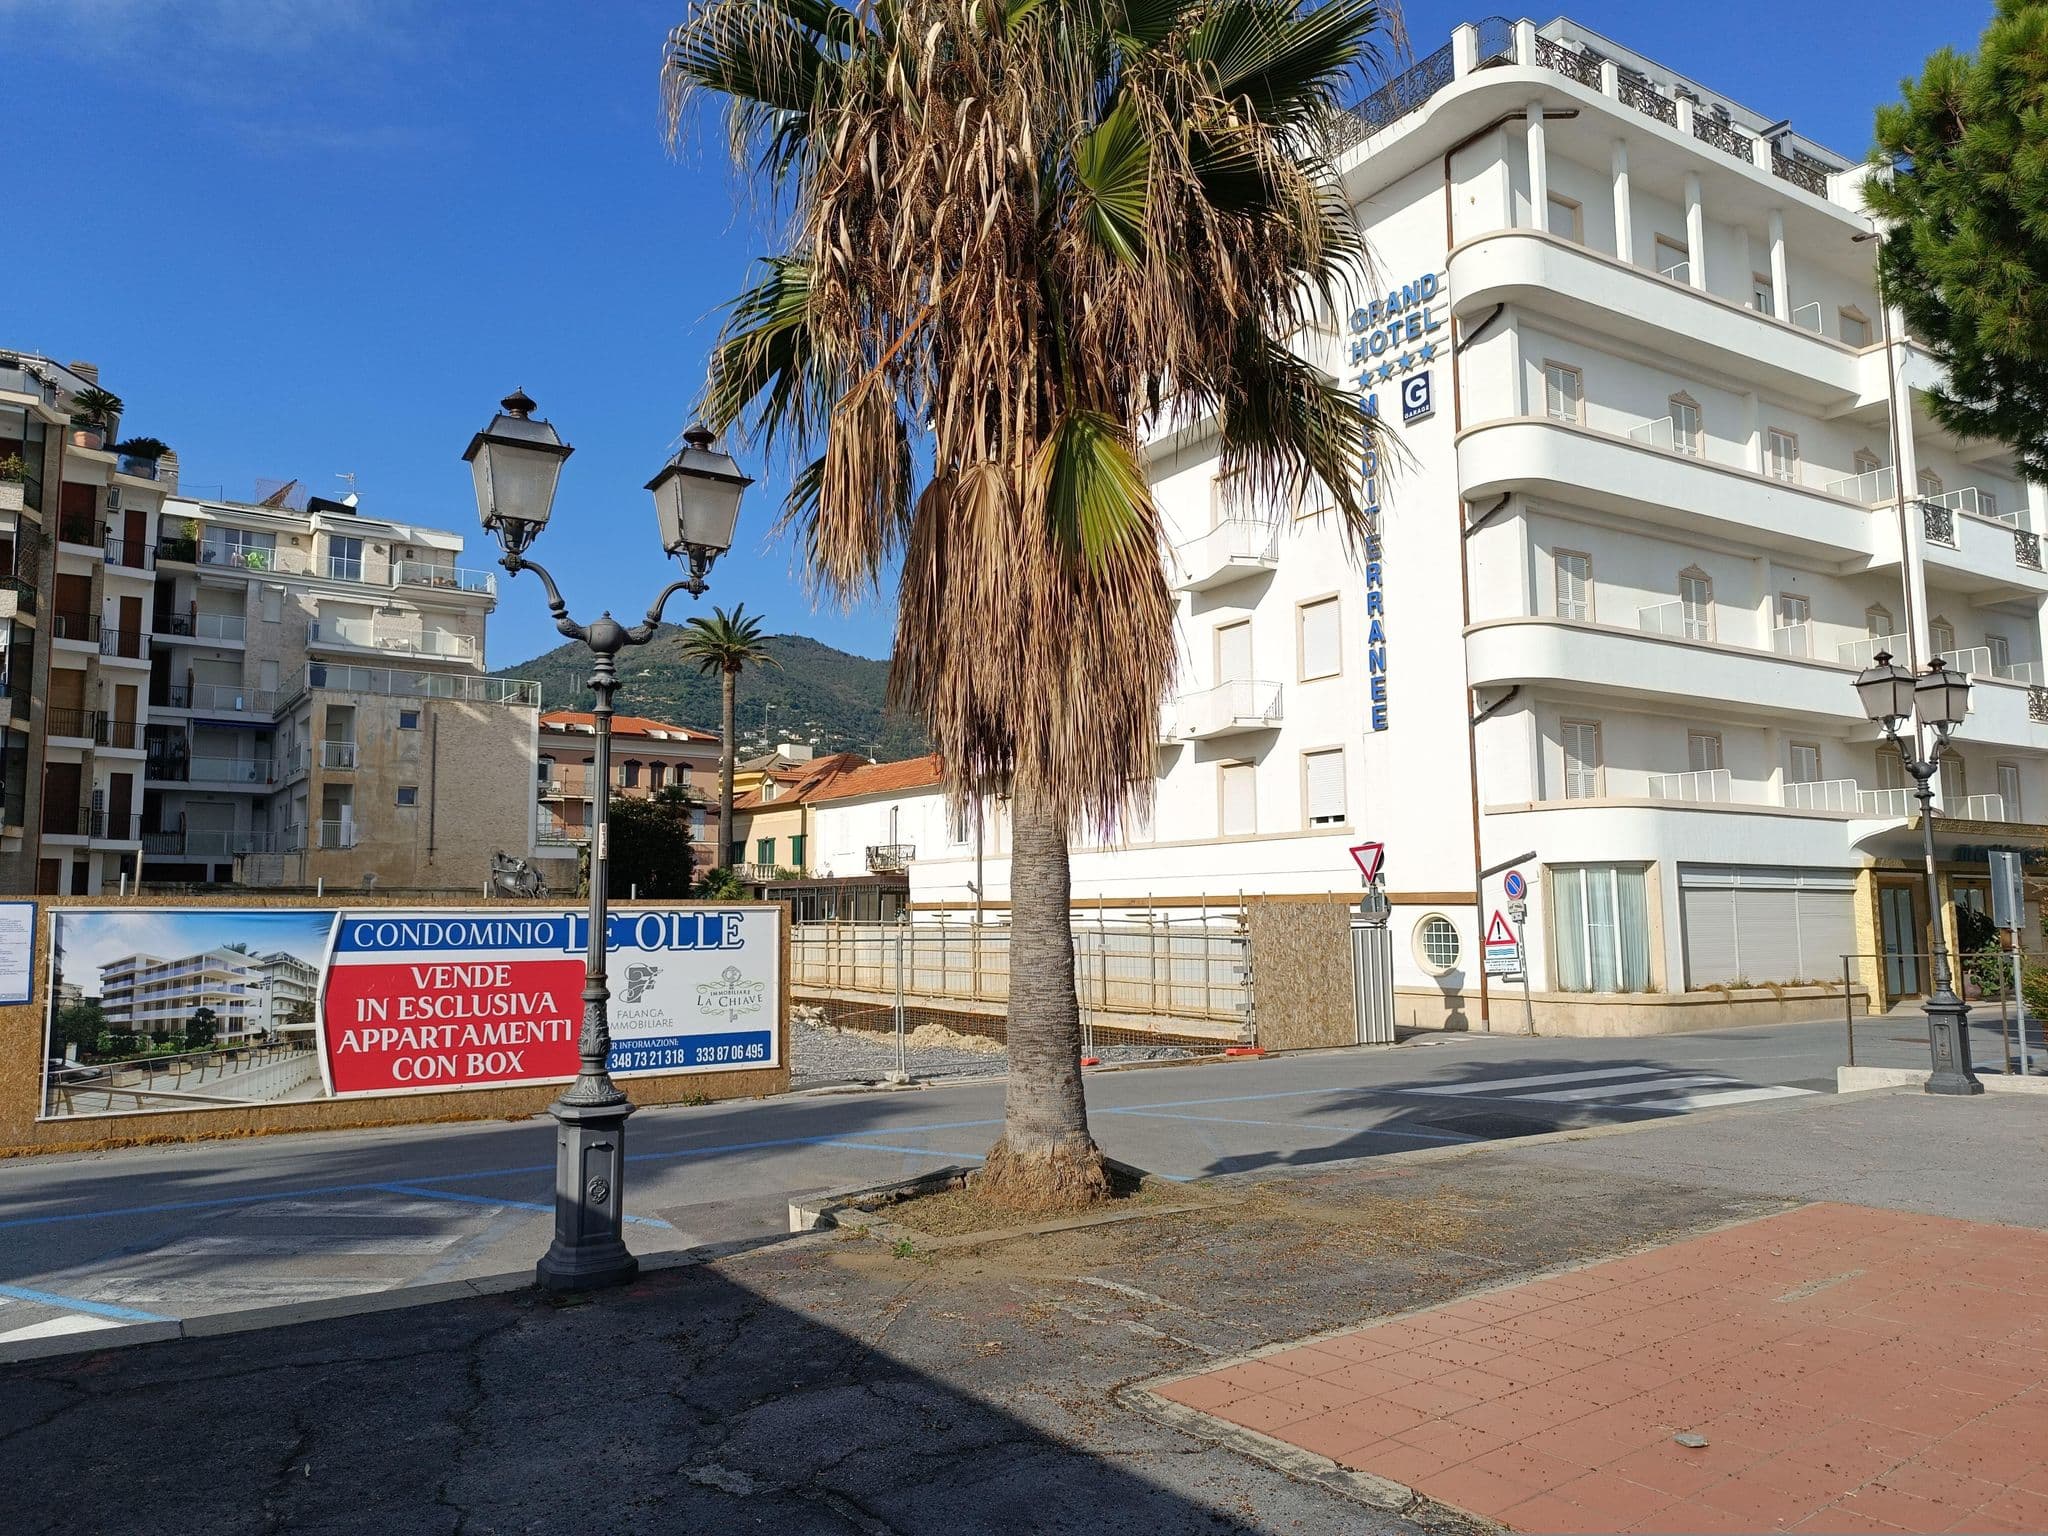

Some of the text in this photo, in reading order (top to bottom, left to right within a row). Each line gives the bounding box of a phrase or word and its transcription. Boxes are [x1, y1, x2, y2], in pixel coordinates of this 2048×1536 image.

[1351, 273, 1438, 334] GRAND
[1352, 307, 1440, 365] HOTEL
[1405, 377, 1427, 408] G
[1405, 405, 1430, 419] GARAGE
[353, 922, 554, 947] CONDOMINIO
[634, 911, 744, 951] OLLE
[410, 964, 512, 989] VENDE
[356, 991, 558, 1022] IN ESCLUSIVA
[697, 993, 763, 1008] LA CHIAVE
[710, 989, 751, 997] IMMOBILIARE
[609, 1018, 674, 1030] MMOBILIARE
[616, 1008, 665, 1019] FALANGA
[336, 1019, 572, 1054] APPARTAMENTI
[392, 1050, 525, 1081] CON BOX
[611, 1052, 632, 1069] 348
[634, 1051, 647, 1067] 73
[649, 1050, 662, 1066] 21
[665, 1048, 685, 1065] 318
[696, 1047, 715, 1063] 333
[716, 1046, 729, 1061] 87
[731, 1044, 744, 1060] 06
[745, 1043, 764, 1058] 495
